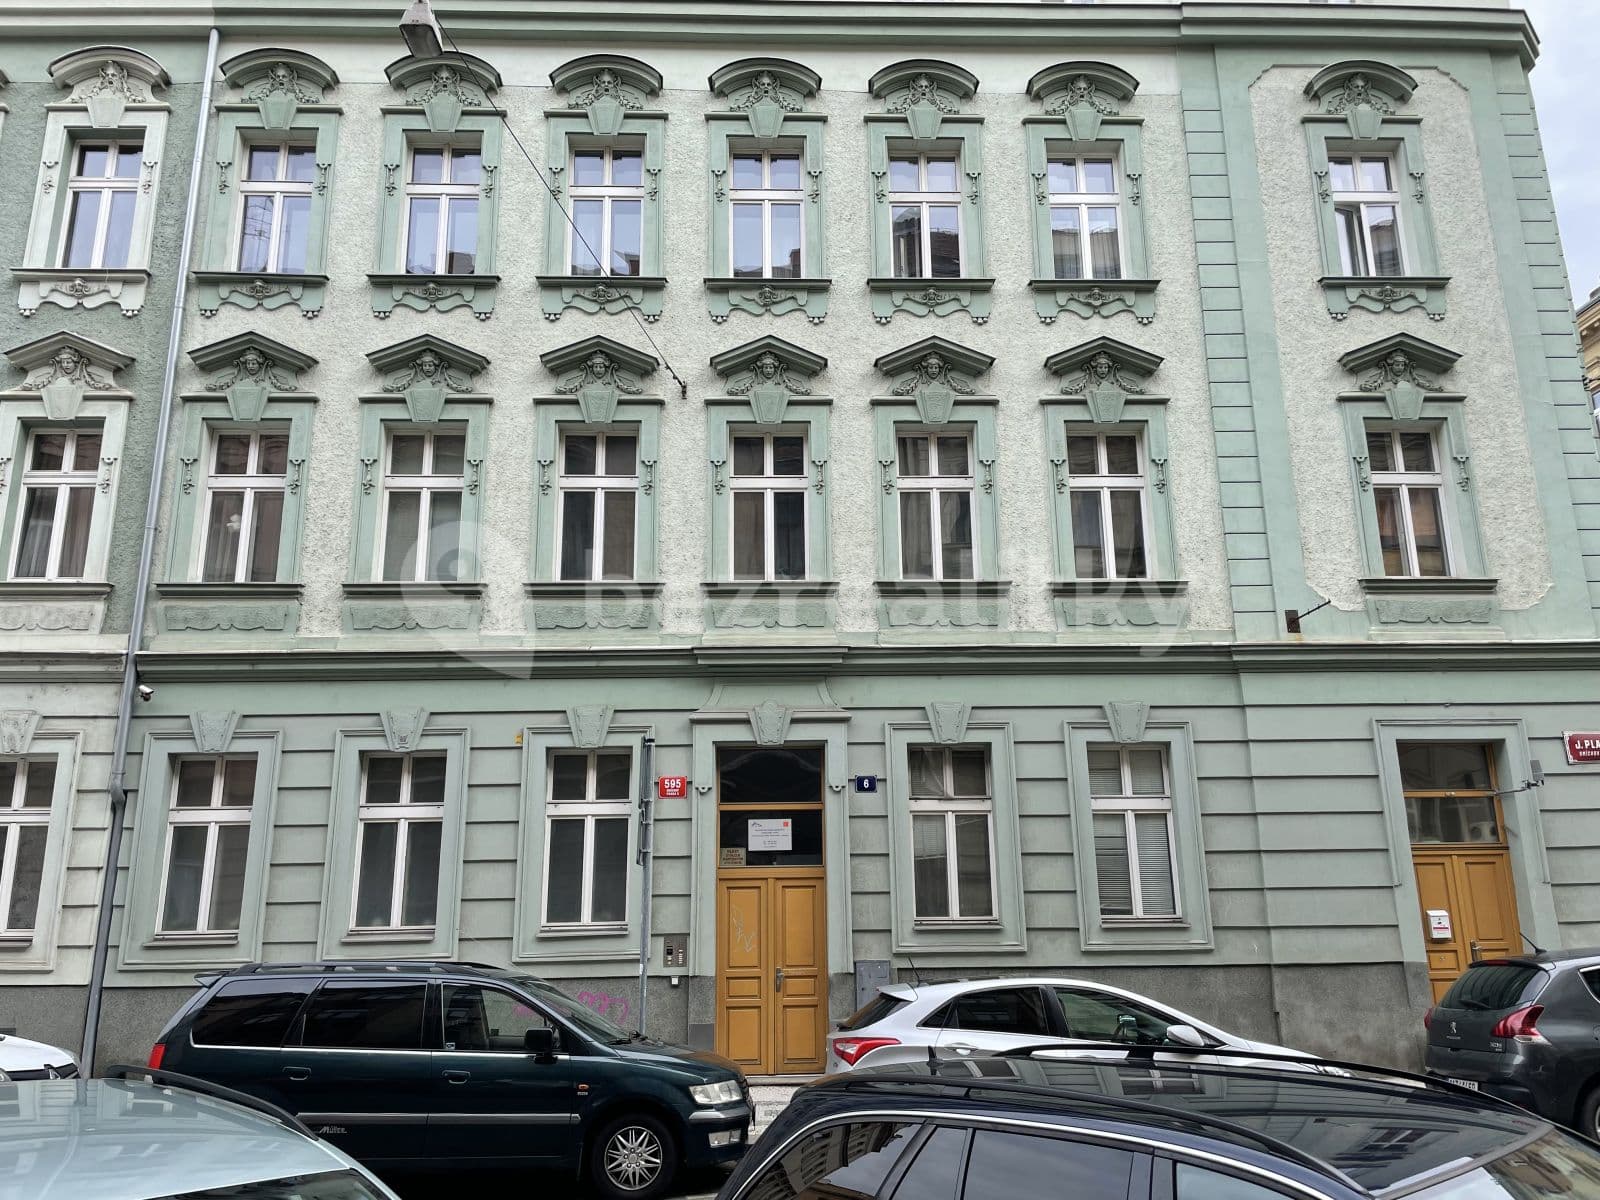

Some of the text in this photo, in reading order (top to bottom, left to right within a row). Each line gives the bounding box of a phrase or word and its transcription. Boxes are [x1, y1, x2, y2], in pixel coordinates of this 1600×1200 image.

[1575, 739, 1583, 749] J.
[664, 778, 682, 789] 595
[863, 778, 869, 789] 6
